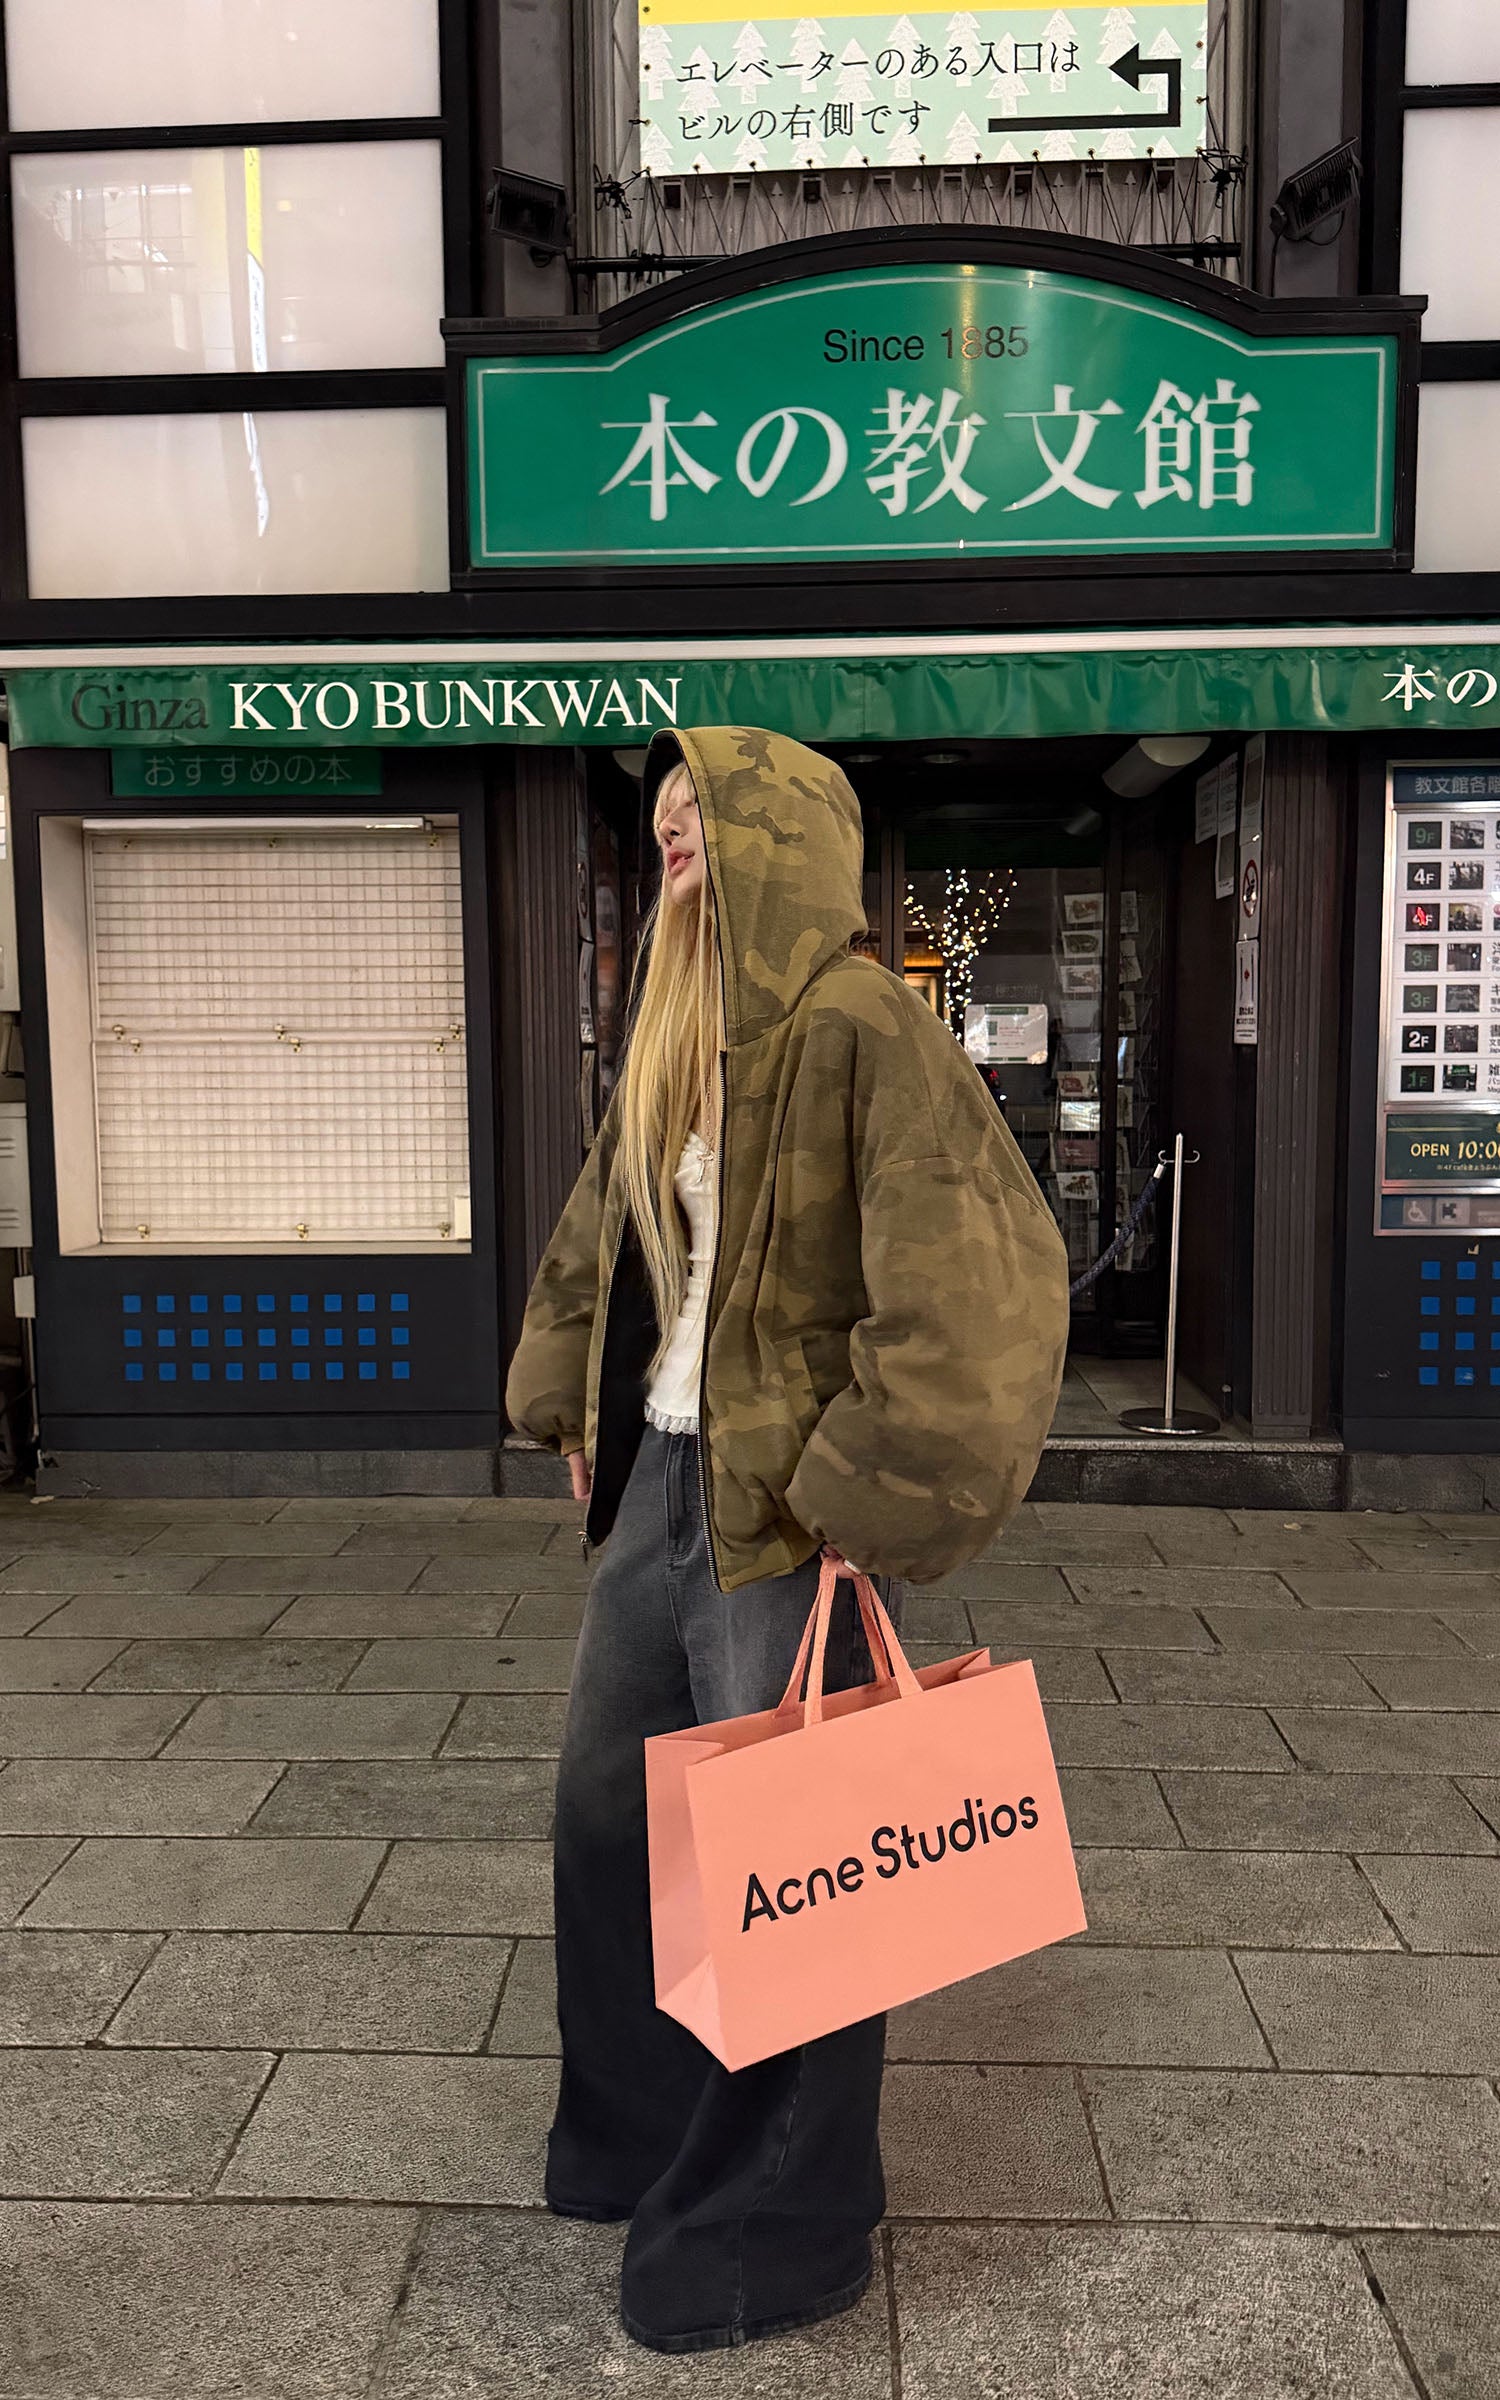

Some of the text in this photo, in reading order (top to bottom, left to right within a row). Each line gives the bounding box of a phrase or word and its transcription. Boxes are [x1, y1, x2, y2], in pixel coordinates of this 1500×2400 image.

[676, 41, 1080, 83] エレベーターのある入口は
[678, 100, 931, 140] ビルの右側です
[823, 325, 1030, 364] Since 1885
[599, 378, 1262, 522] 本の教文館
[1380, 663, 1498, 711] 本の
[71, 678, 682, 731] Ginza KYO BUNKWAN
[145, 754, 352, 786] おすすめの本
[1415, 827, 1436, 844] 9F
[1413, 867, 1435, 885] 4F
[1412, 950, 1432, 966] 3F
[1410, 991, 1431, 1008] 3F
[1409, 1030, 1430, 1048] 2F
[1408, 1071, 1428, 1088] 1F
[1410, 1141, 1500, 1159] OPEN 10:0
[742, 1796, 1039, 1933] Acne Studios
